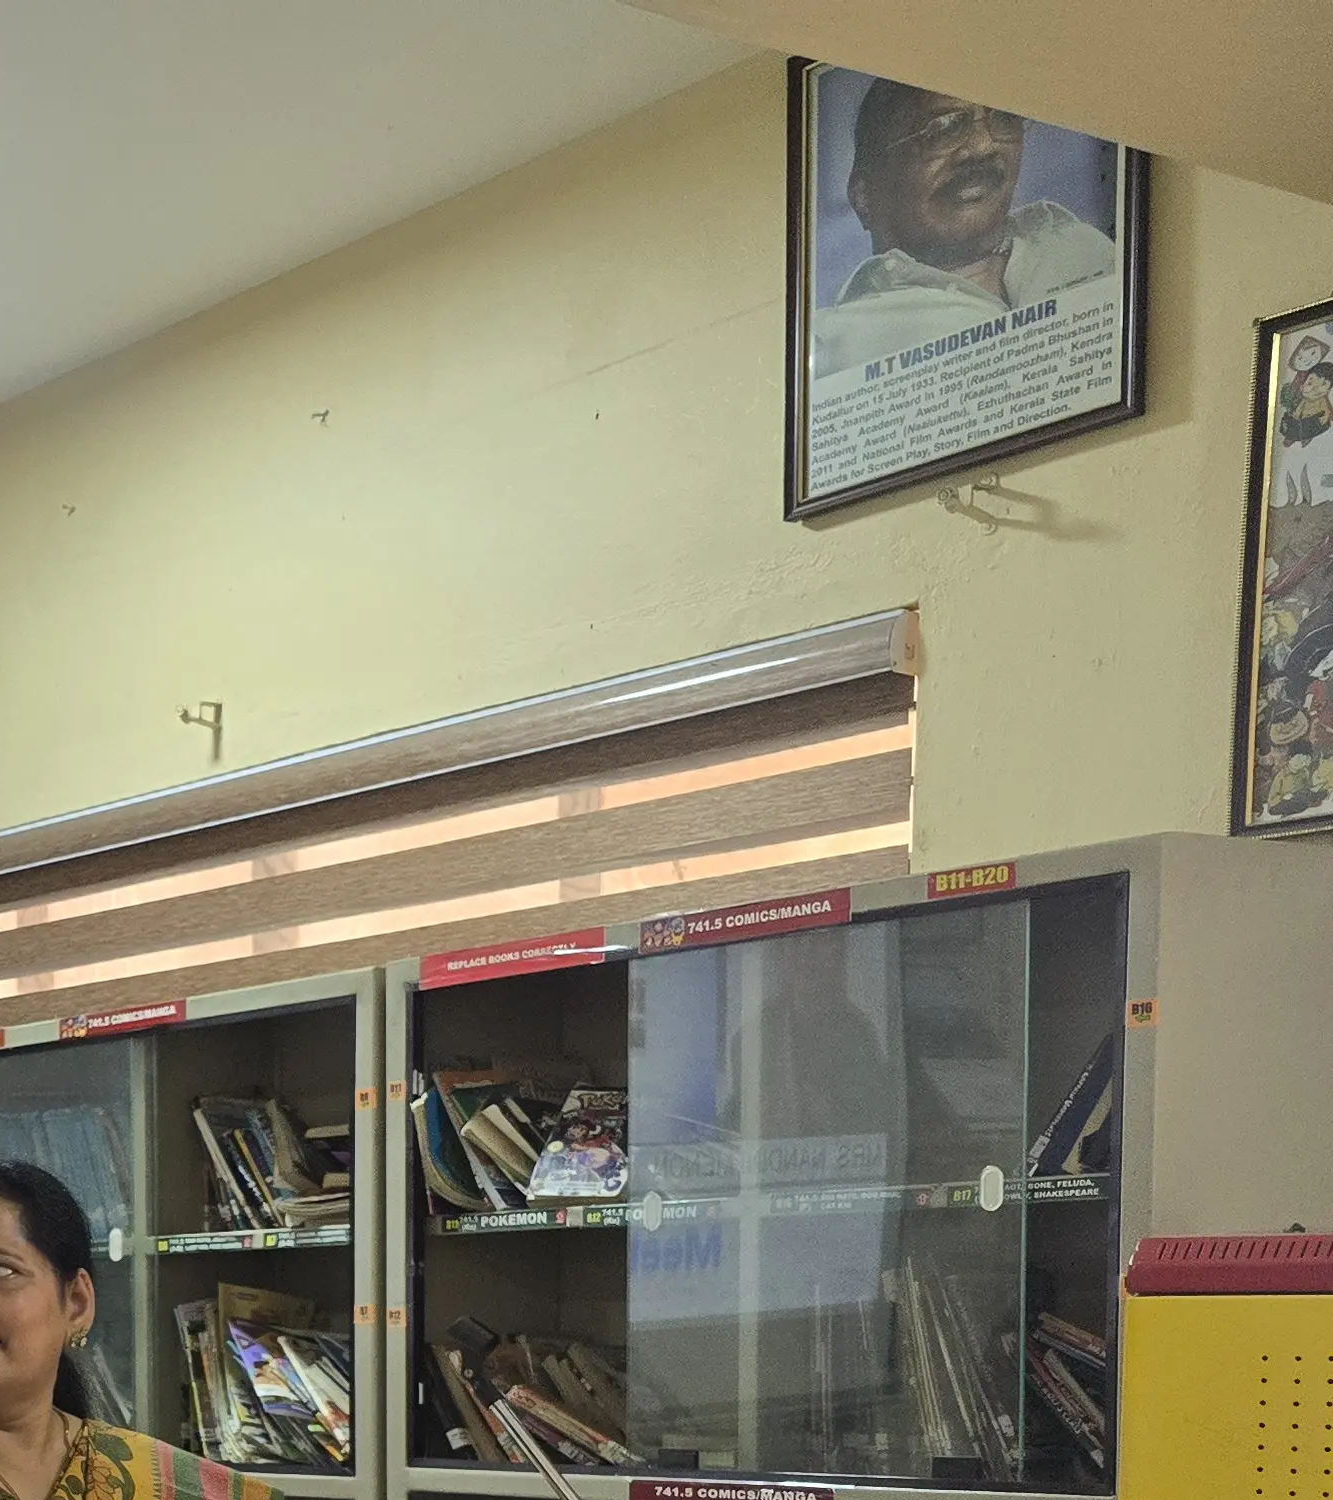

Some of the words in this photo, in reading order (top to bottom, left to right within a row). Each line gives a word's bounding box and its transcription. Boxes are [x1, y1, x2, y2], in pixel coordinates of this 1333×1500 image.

[812, 396, 841, 412] Indian
[883, 362, 940, 388] screenplay
[942, 349, 973, 367] writer
[975, 342, 995, 357] and
[999, 334, 1019, 349] film
[1072, 306, 1099, 323] born
[1103, 302, 1114, 313] in
[865, 356, 896, 382] M.T
[900, 316, 1007, 369] VASUDEVAN
[1011, 299, 1057, 330] NAIR
[885, 387, 907, 402] July
[940, 359, 991, 382] Recipient
[993, 354, 1004, 365] of
[1007, 341, 1045, 358] Padma
[1049, 323, 1099, 344] Bhushan
[1103, 317, 1113, 328] in
[888, 397, 921, 414] Award
[925, 391, 935, 401] in
[939, 381, 963, 396] 1995
[1071, 332, 1113, 352] Kendra
[811, 433, 848, 451] Sahitya
[858, 415, 906, 437] Academy
[916, 401, 949, 418] Award
[1022, 364, 1058, 383] Kerala
[1069, 346, 1112, 367] Sahitya
[811, 443, 857, 465] Academy
[864, 431, 897, 448] Award
[977, 381, 1048, 411] Ezhuthachan
[1057, 366, 1093, 386] Award
[1102, 360, 1112, 371] in
[811, 465, 833, 478] 2011
[838, 456, 857, 469] and
[862, 442, 904, 461] National
[910, 432, 932, 446] Film
[937, 419, 977, 438] Awards
[984, 408, 1004, 423] and
[1010, 396, 1045, 415] Kerala
[1052, 385, 1080, 401] State
[1087, 375, 1112, 390] Film
[811, 473, 847, 491] Awards
[851, 466, 864, 478] for
[867, 455, 903, 474] Screen
[934, 437, 963, 453] Story,
[967, 427, 991, 442] Film
[993, 419, 1014, 434] and
[1017, 403, 1071, 426] Direction.
[687, 918, 723, 934] 741.5
[726, 898, 832, 929] COMICS/MANGA
[936, 865, 1009, 892] B11-B20
[447, 957, 486, 971] REPLACE
[488, 951, 521, 966] BOOKS
[480, 1212, 547, 1228] POKEMON
[1034, 1187, 1100, 1199] SHAKESPEARE
[654, 1485, 694, 1499] 741.5
